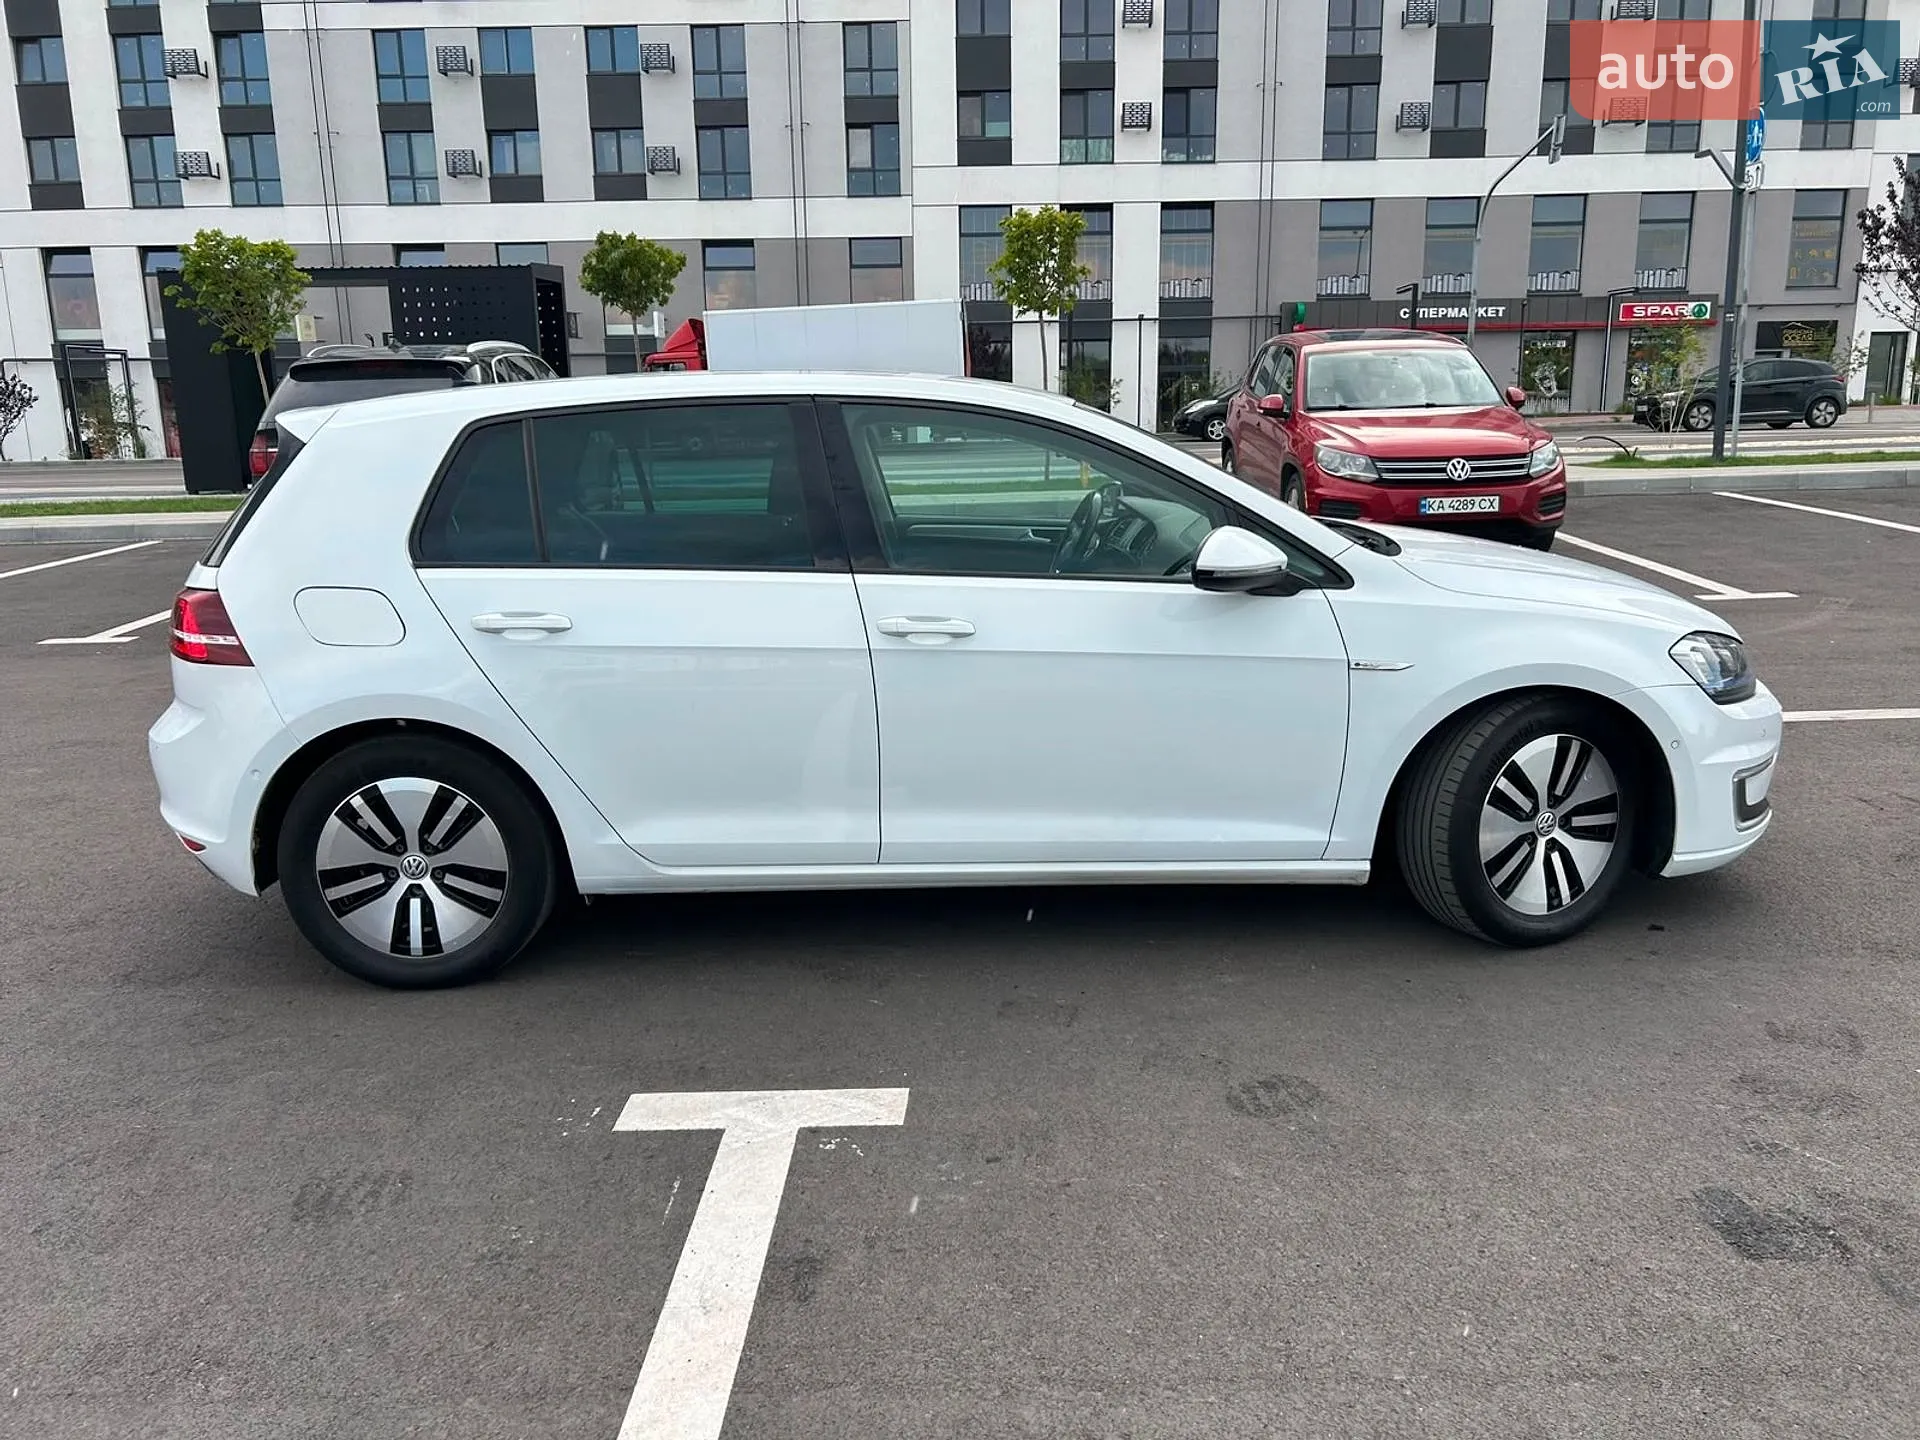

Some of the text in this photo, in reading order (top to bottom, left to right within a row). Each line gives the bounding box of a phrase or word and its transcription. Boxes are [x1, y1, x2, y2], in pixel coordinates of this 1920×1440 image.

[1400, 307, 1506, 319] СПЕРМАКЕТ
[1632, 305, 1690, 318] SPAR
[1427, 498, 1496, 512] KA 4289 CX
